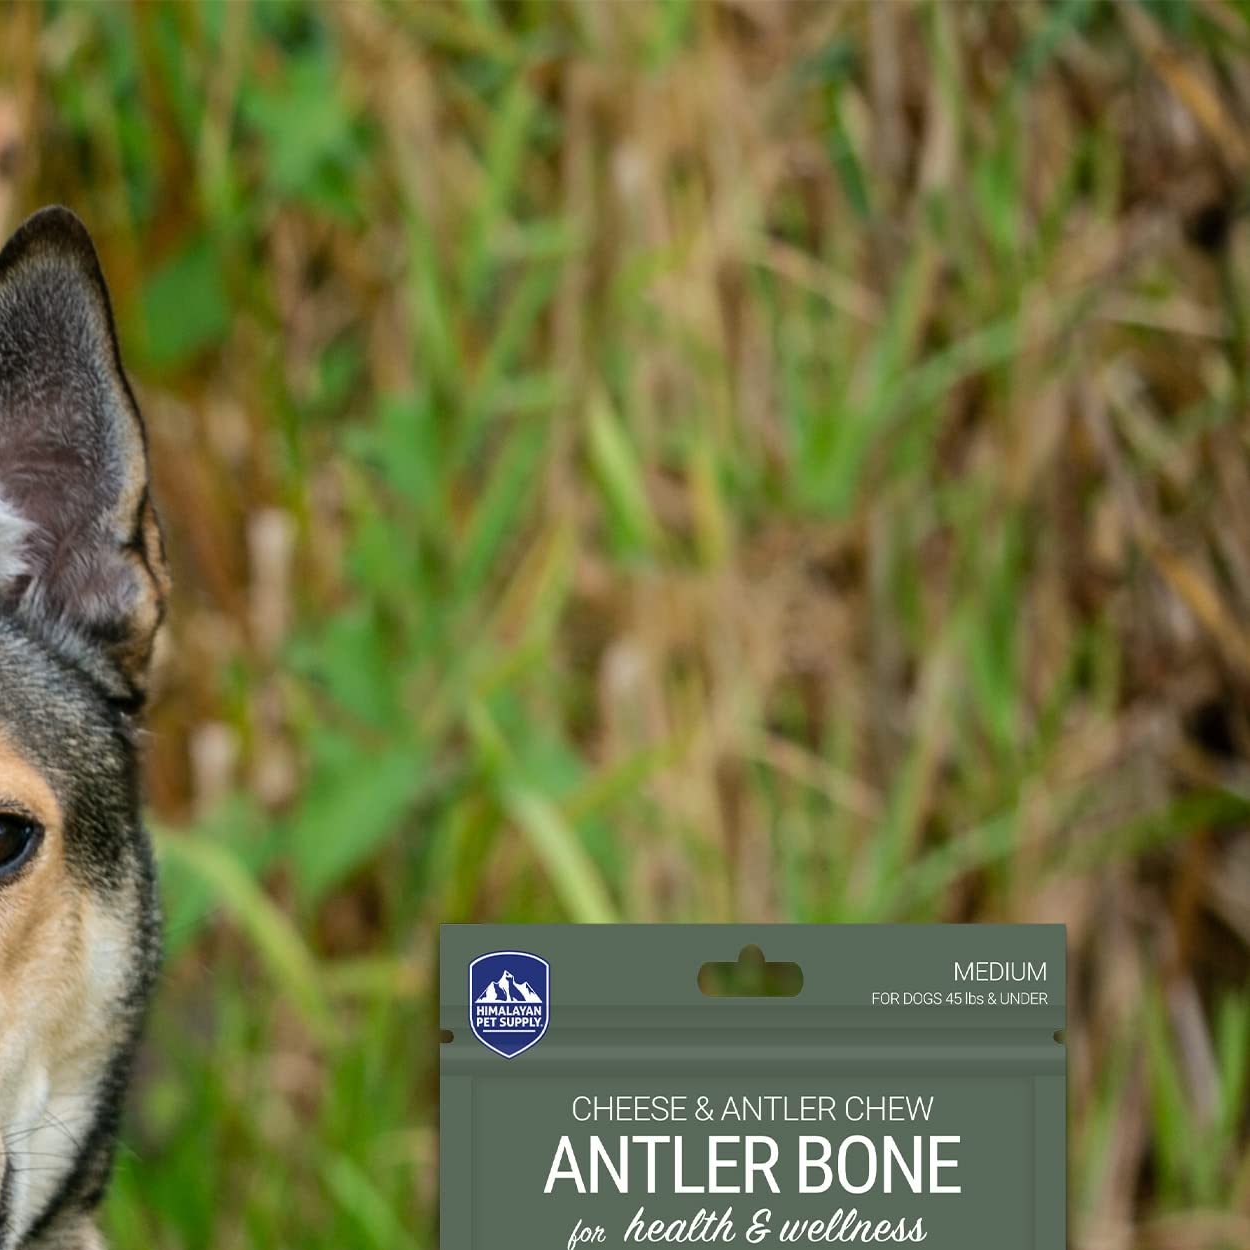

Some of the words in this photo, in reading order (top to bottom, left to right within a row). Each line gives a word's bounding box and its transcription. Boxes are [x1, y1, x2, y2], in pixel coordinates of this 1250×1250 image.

[954, 961, 1047, 982] MEDIUM
[871, 991, 900, 1006] FOR
[903, 991, 943, 1006] DOGS
[945, 991, 963, 1006] 45
[965, 991, 985, 1006] lbs
[987, 991, 998, 1006] &
[999, 991, 1049, 1006] UNDER
[476, 1005, 542, 1016] HIMALAYAN
[476, 1017, 497, 1027] PET
[572, 1095, 688, 1122] CHEESE
[694, 1095, 715, 1122] &
[720, 1095, 837, 1122] ANTLER
[845, 1095, 935, 1122] CHEW
[542, 1135, 782, 1194] ANTLER
[798, 1134, 962, 1195] BONE
[623, 1205, 737, 1243] health
[745, 1207, 773, 1244] &
[779, 1206, 928, 1244] wellness
